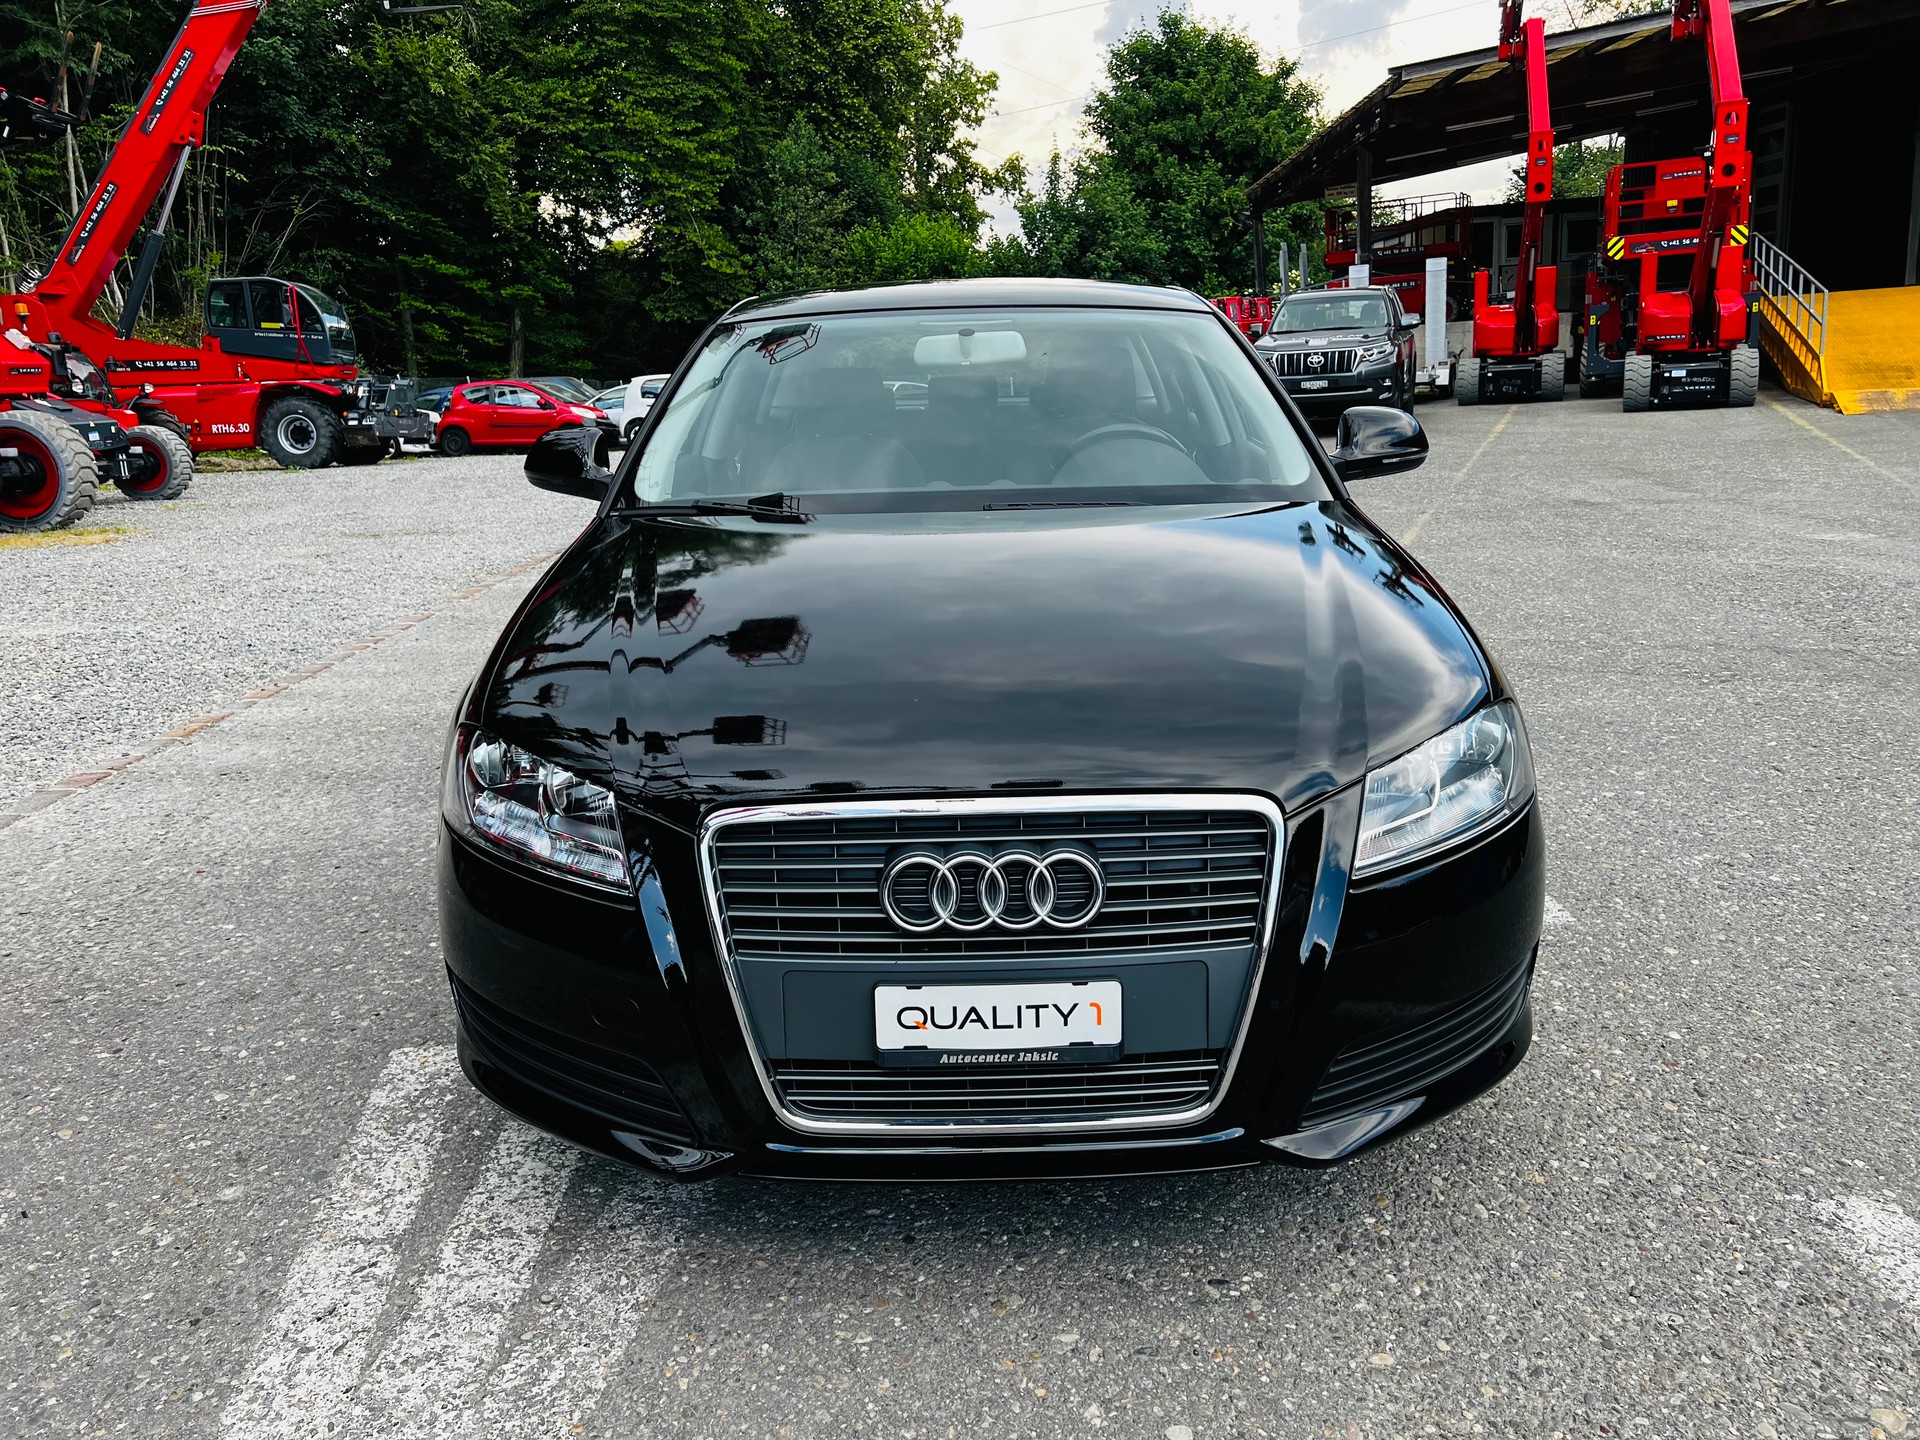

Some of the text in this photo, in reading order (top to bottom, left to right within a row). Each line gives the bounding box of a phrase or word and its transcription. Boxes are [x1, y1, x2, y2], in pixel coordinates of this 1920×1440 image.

[166, 79, 174, 88] 56
[171, 67, 181, 79] 464
[178, 59, 186, 67] 31
[183, 49, 191, 58] 31
[90, 211, 98, 220] 56
[95, 200, 105, 212] 464
[101, 192, 109, 200] 31
[106, 183, 114, 192] 31
[211, 423, 250, 434] RTH6.30
[896, 1002, 1080, 1031] QUALITY
[940, 1051, 1059, 1064] Autocenter Jaksic
